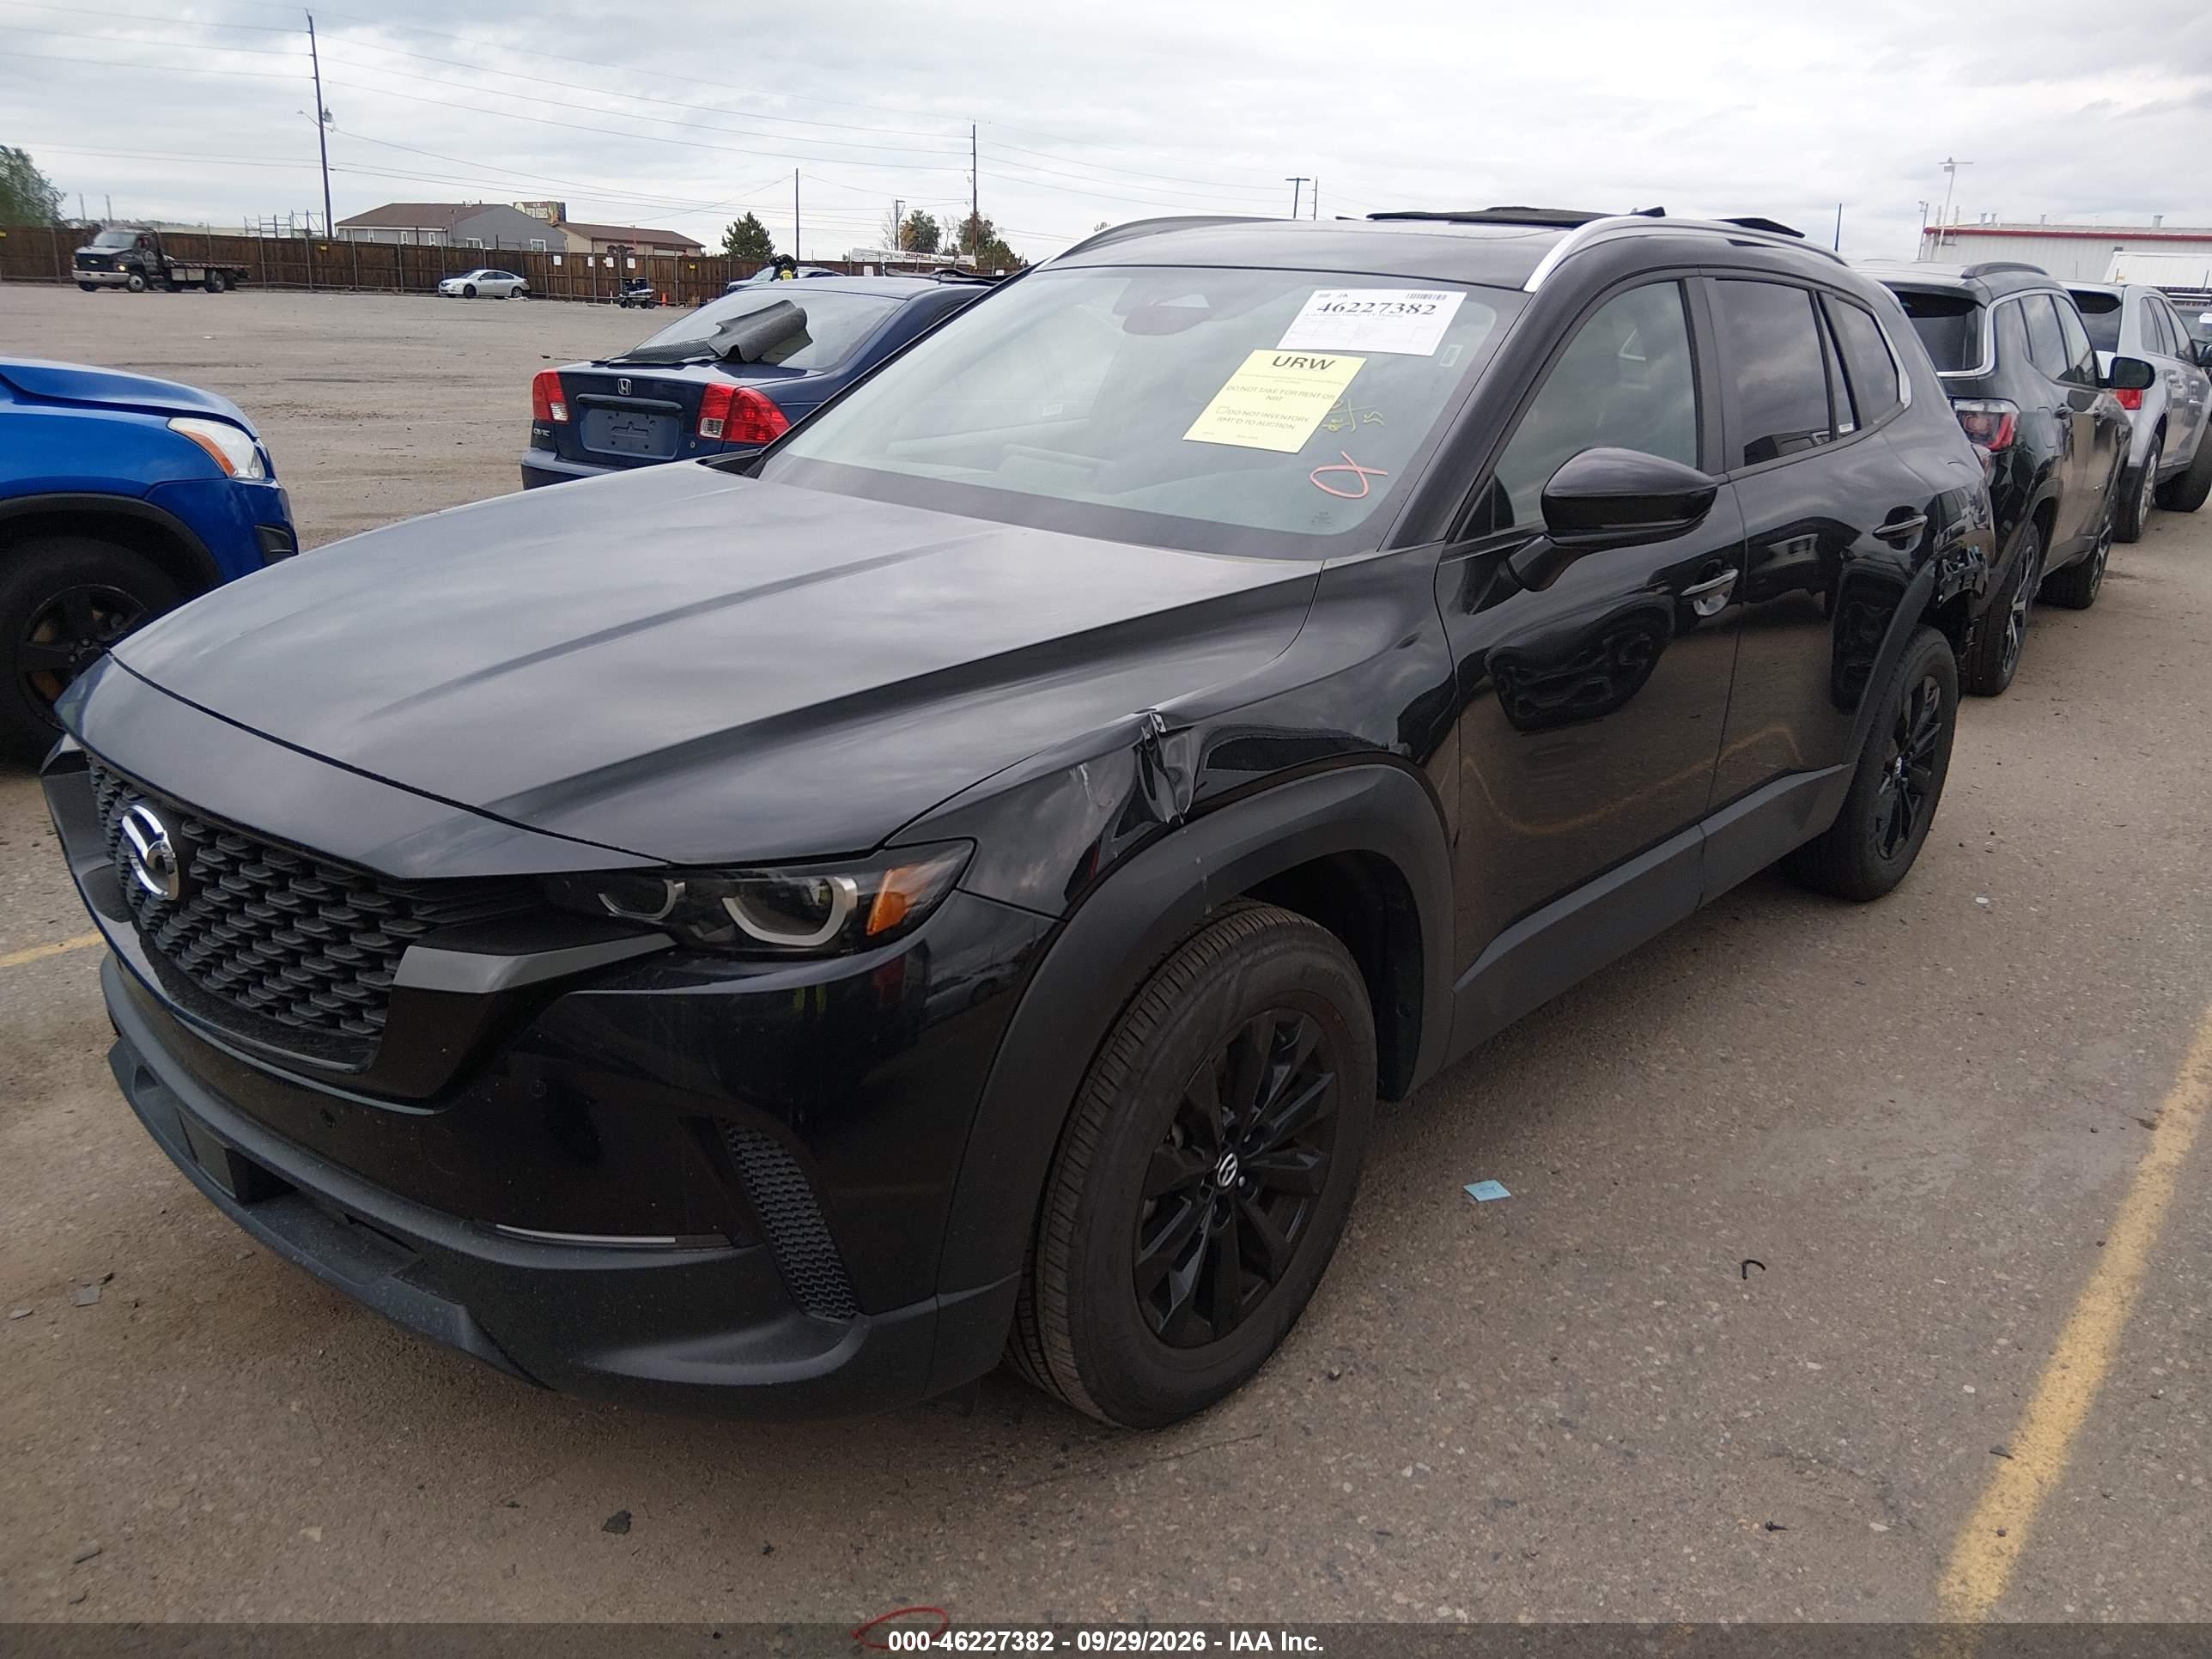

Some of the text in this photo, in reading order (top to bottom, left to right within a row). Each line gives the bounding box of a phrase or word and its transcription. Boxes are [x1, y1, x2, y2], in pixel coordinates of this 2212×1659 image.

[1316, 301, 1436, 315] 46227382
[1272, 356, 1336, 370] URW
[1256, 420, 1297, 430] AUCTION
